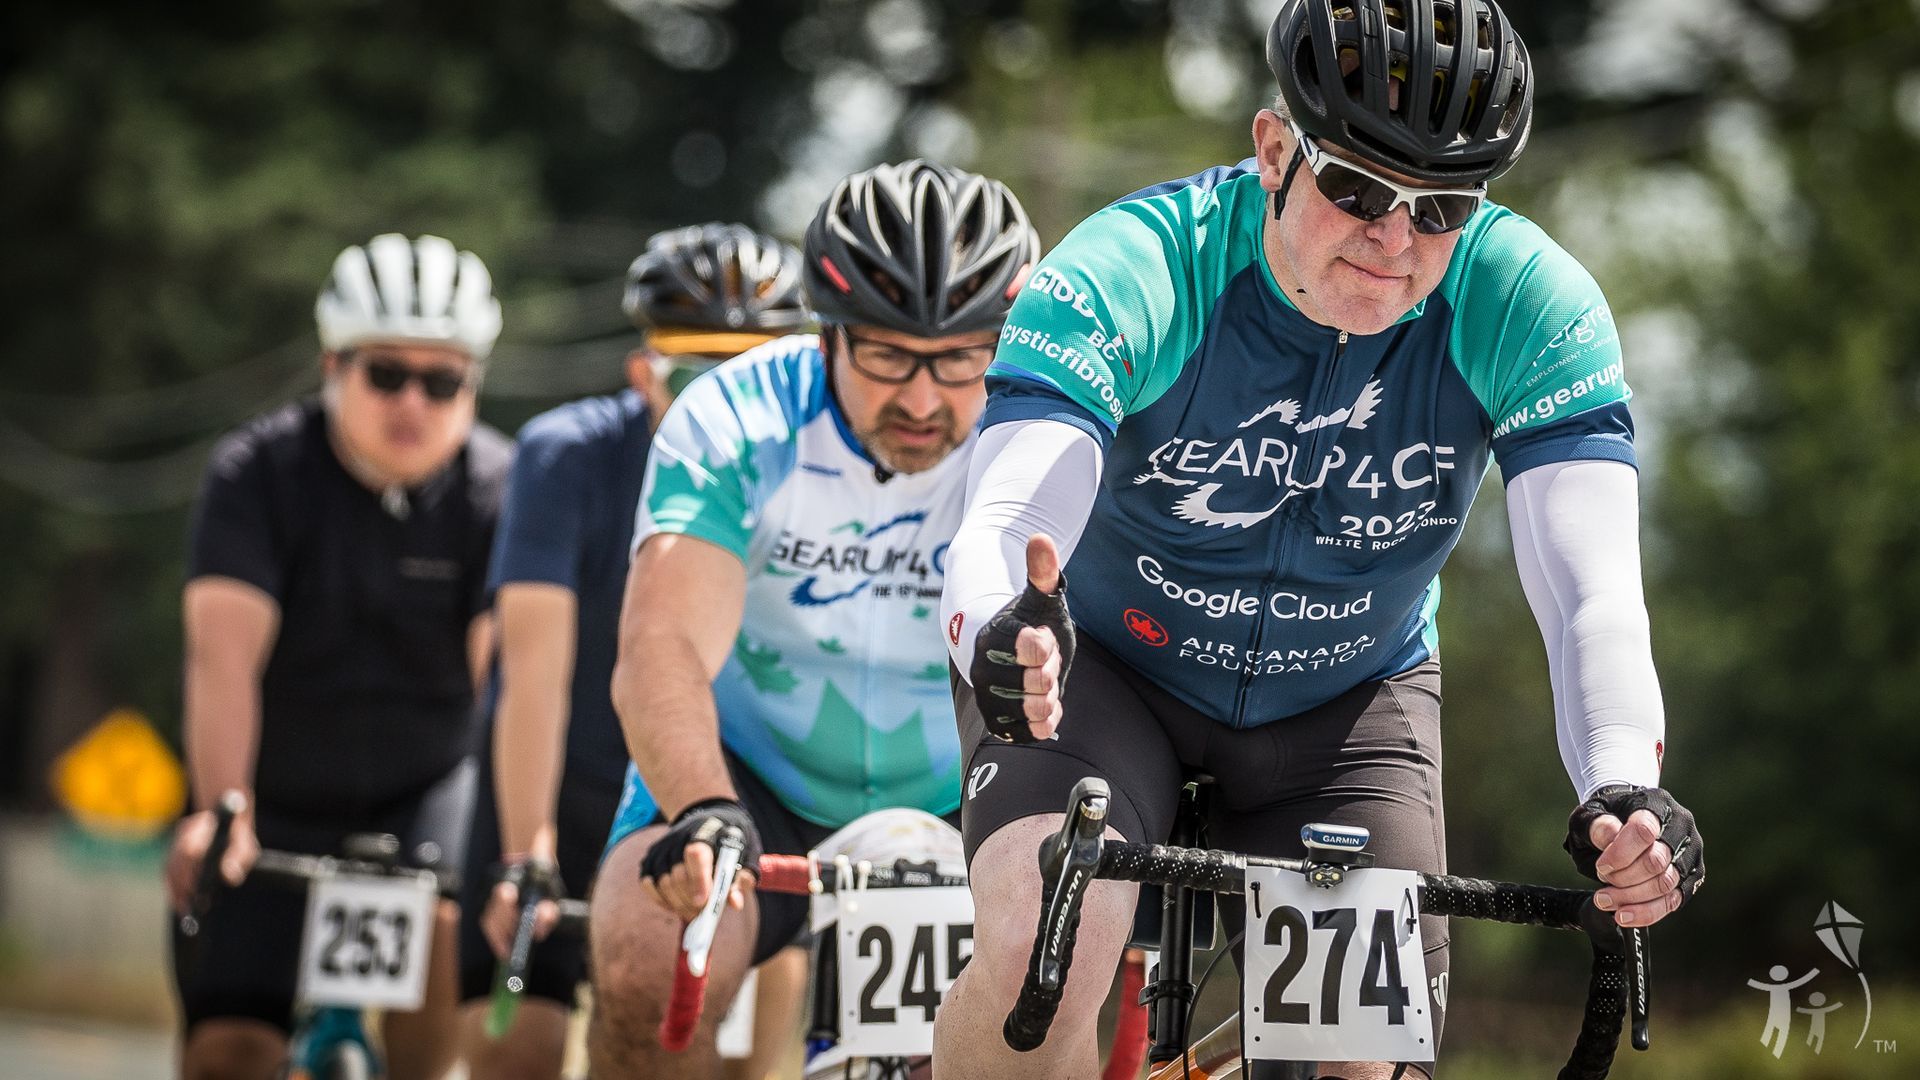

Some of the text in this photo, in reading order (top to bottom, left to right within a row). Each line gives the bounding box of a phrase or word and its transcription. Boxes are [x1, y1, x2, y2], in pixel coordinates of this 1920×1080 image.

[1088, 329, 1121, 361] BC
[1526, 350, 1581, 387] EMPLOYMENT
[1315, 535, 1363, 550] WHITE
[1414, 517, 1458, 532] ONDO
[1136, 555, 1373, 620] Google Cloud
[1179, 637, 1376, 676] FOUNDATION
[1182, 634, 1370, 664] AIR CANADA
[1322, 834, 1361, 845] GARMIN
[1050, 869, 1084, 957] ULTEGRA
[320, 904, 412, 977] 253
[1263, 905, 1411, 1026] 274
[1633, 927, 1646, 1016] ULTEGRA
